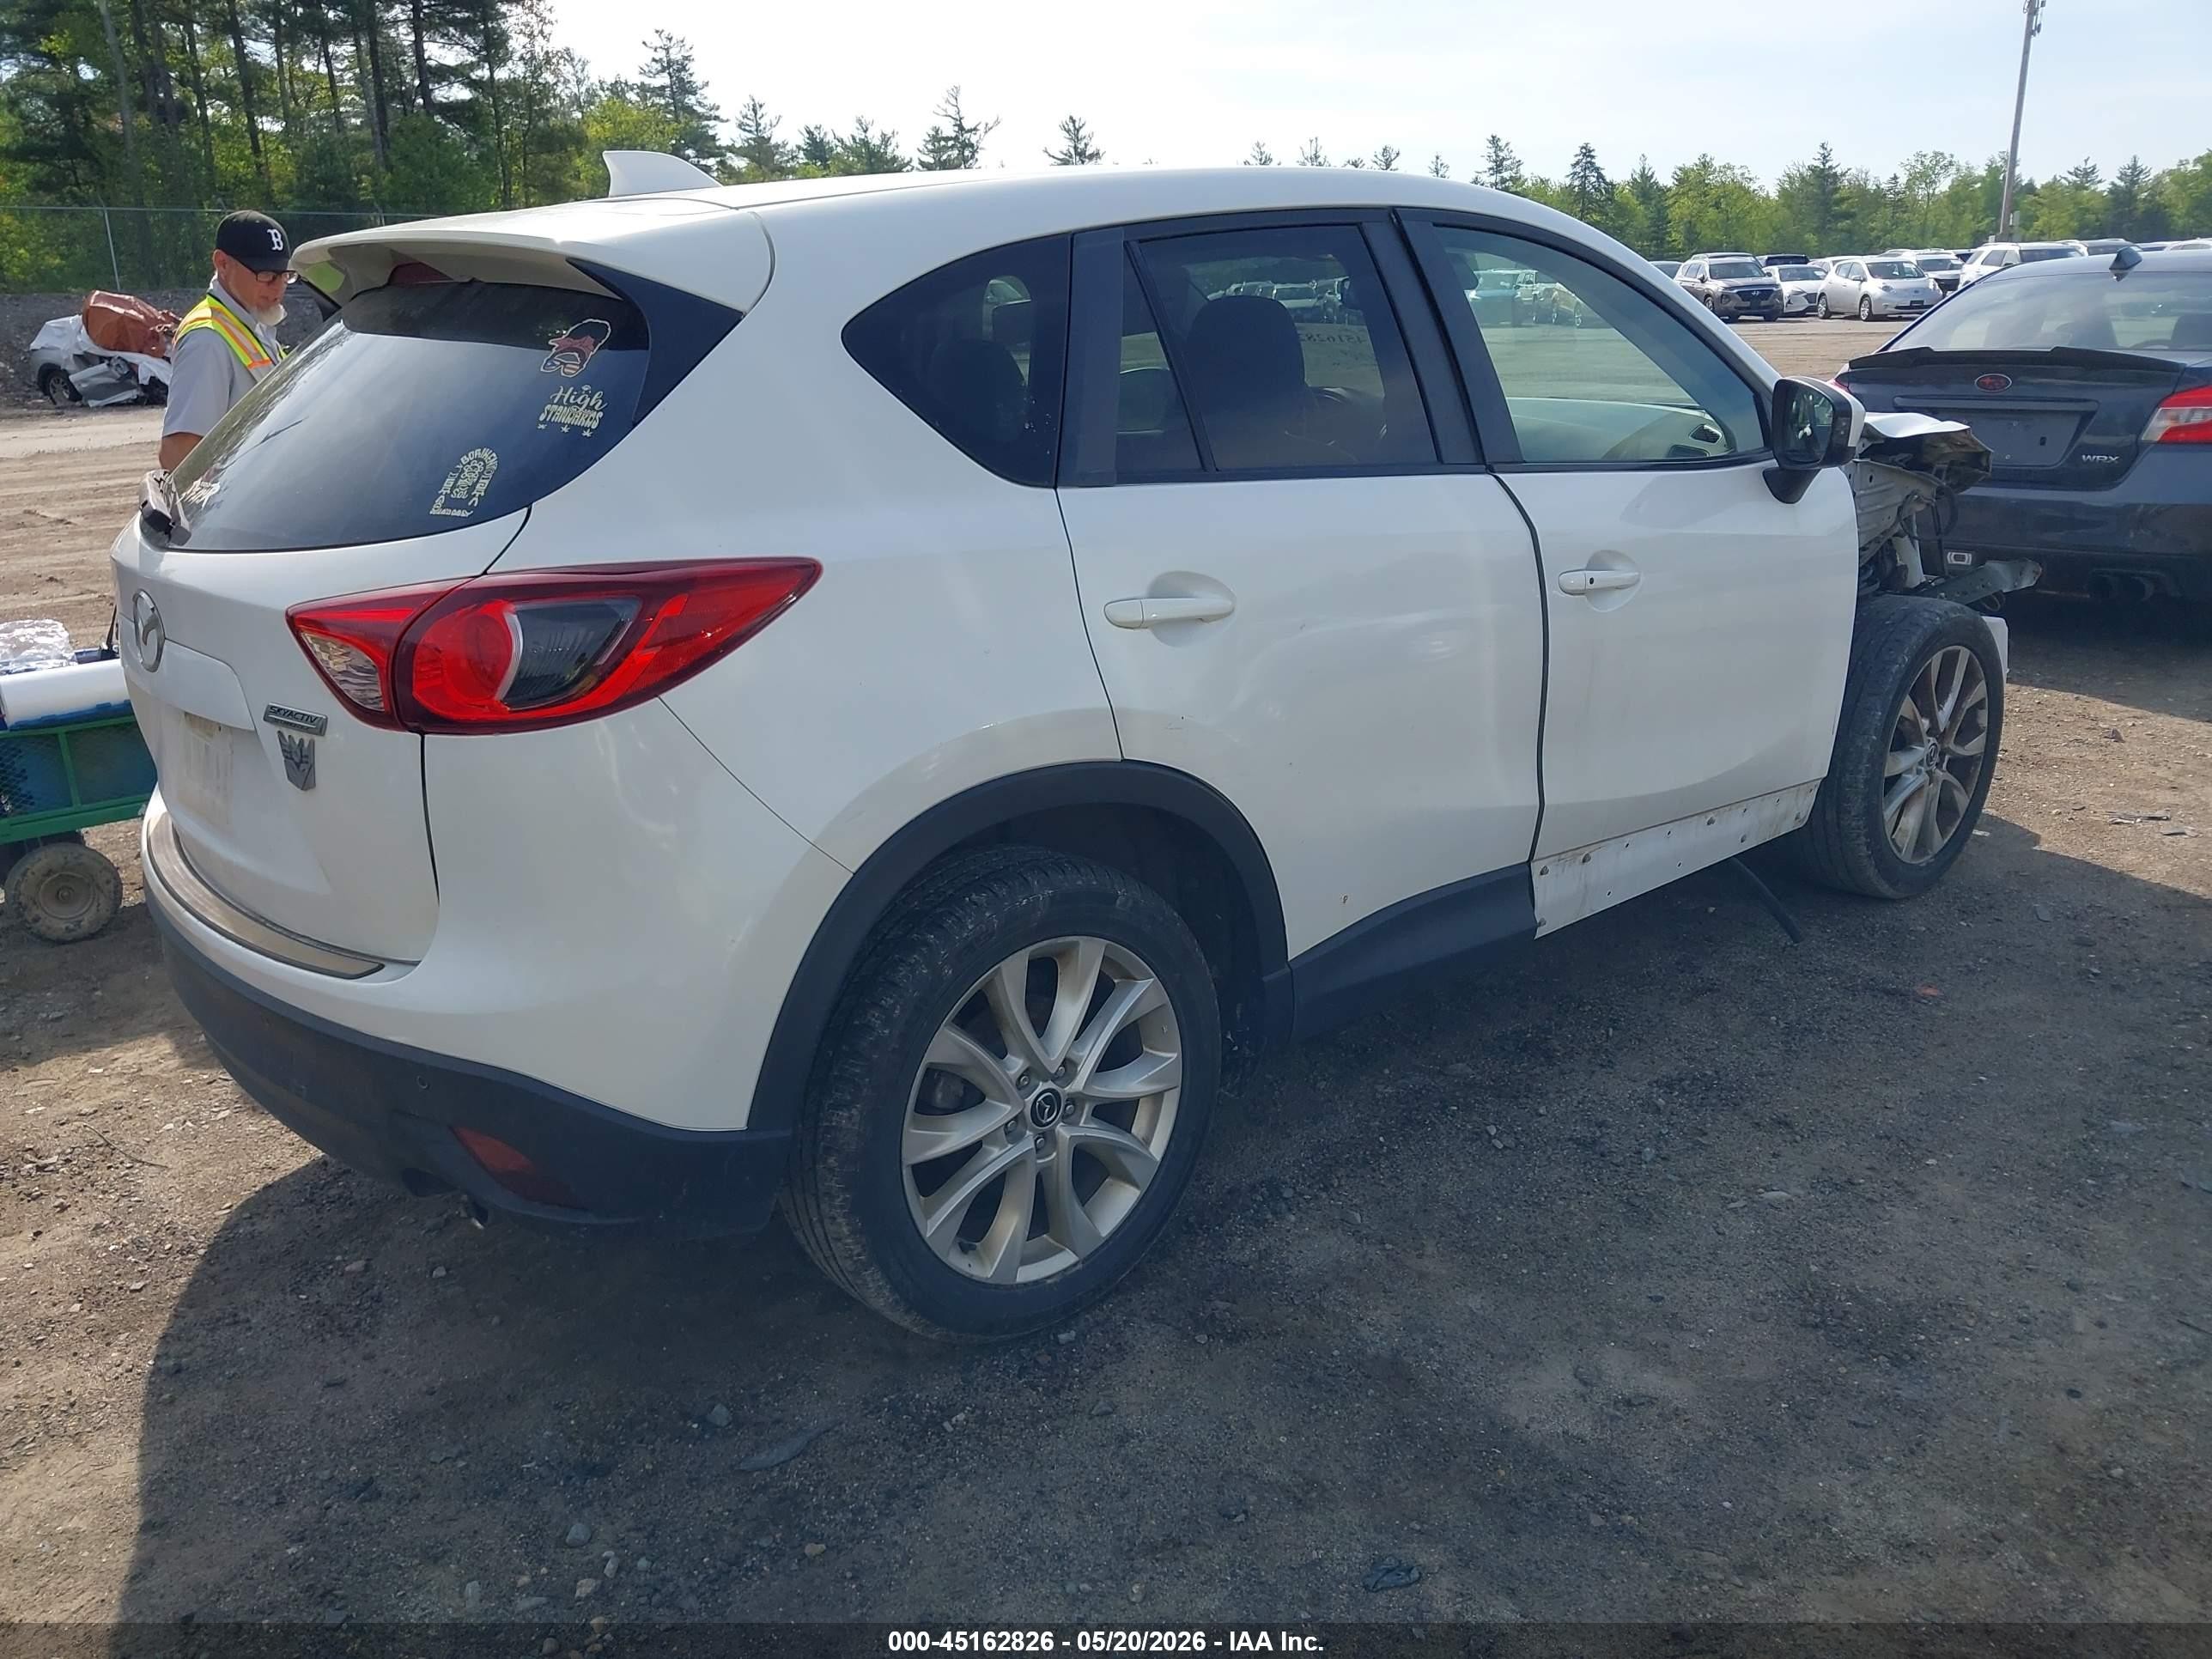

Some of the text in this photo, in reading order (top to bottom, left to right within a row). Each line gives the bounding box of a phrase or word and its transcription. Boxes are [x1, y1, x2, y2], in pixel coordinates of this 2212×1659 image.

[266, 228, 283, 251] B
[550, 386, 608, 413] High
[538, 404, 604, 429] STANDARDS
[2081, 453, 2120, 463] WRX
[269, 706, 319, 723] SKYACTIV
